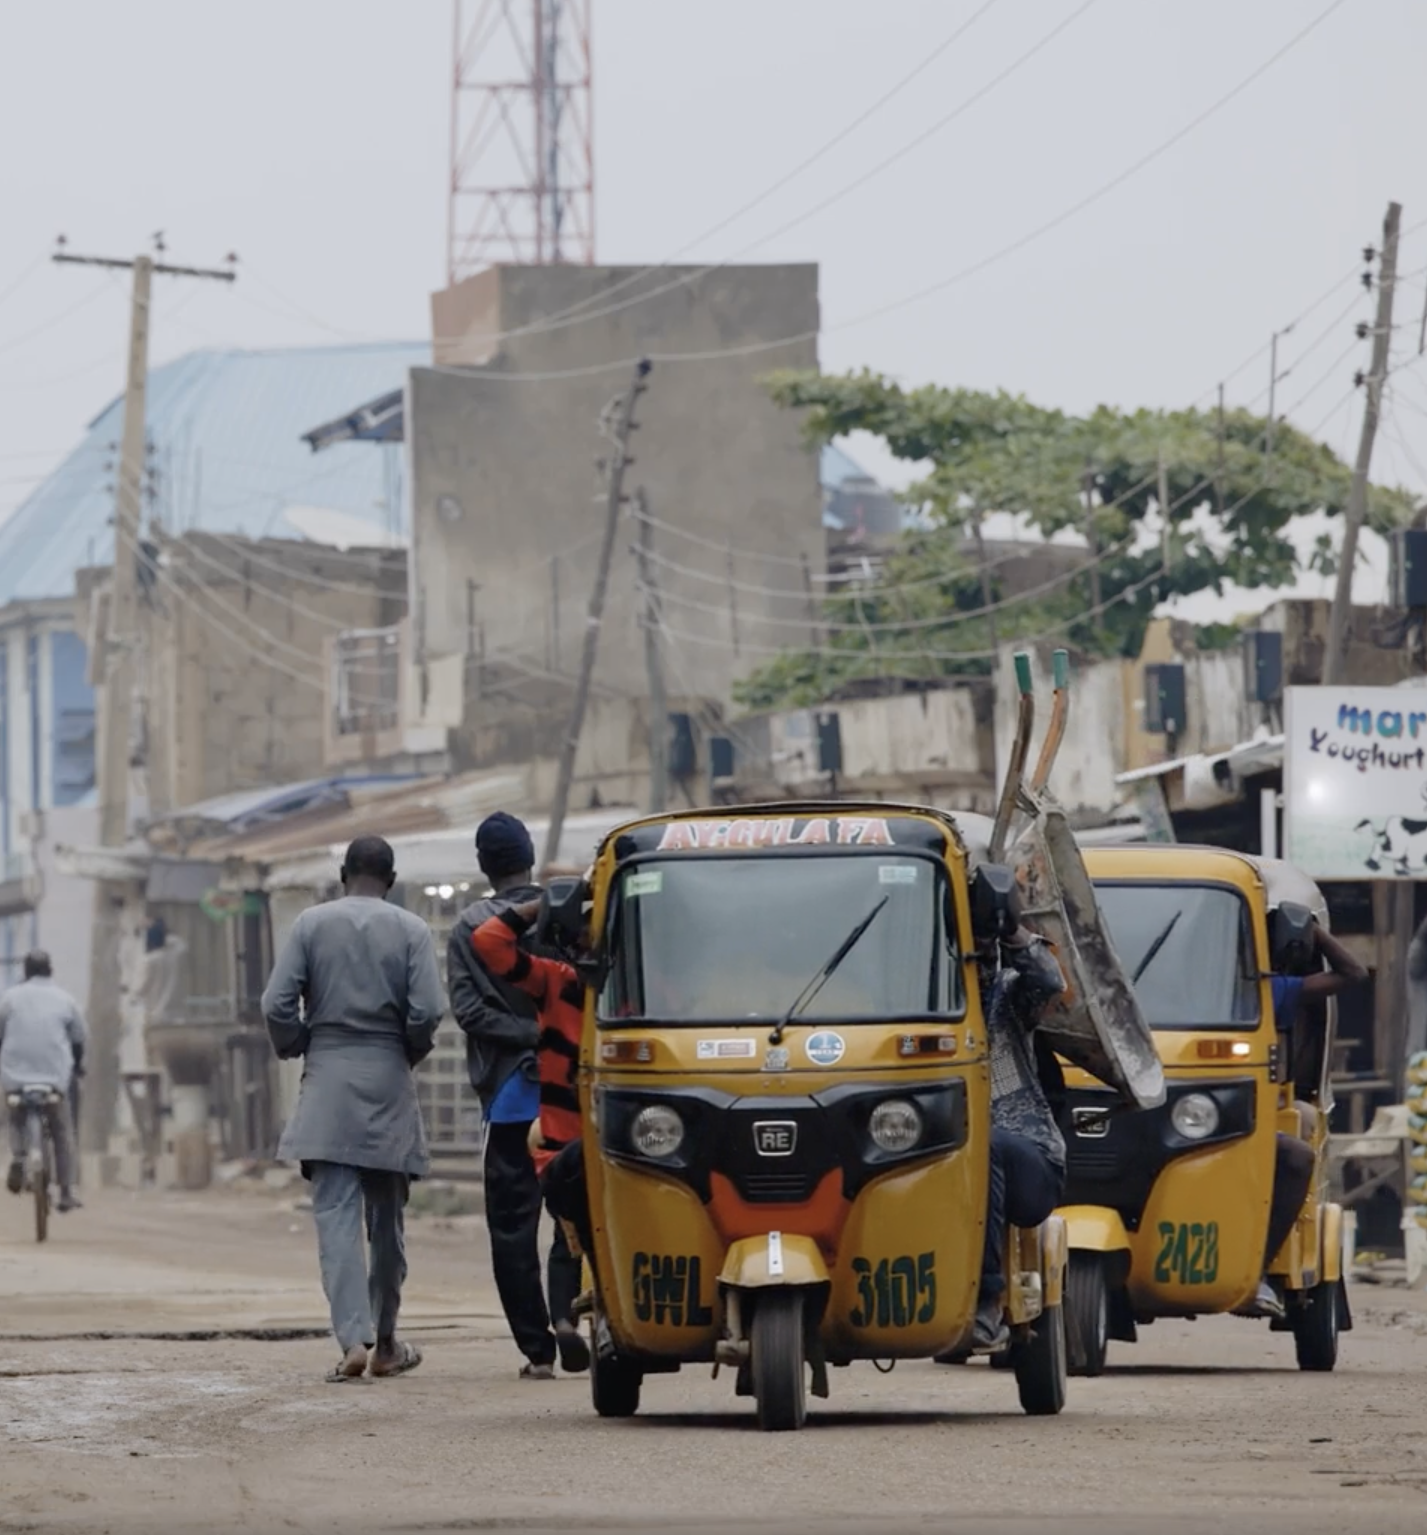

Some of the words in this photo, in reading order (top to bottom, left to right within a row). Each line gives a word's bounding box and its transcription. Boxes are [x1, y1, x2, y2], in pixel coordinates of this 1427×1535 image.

[1309, 727, 1425, 773] Yoghurt
[762, 1132, 790, 1149] RE
[1154, 1221, 1218, 1285] 2428
[633, 1251, 713, 1327] GWL
[849, 1250, 937, 1328] 3105
